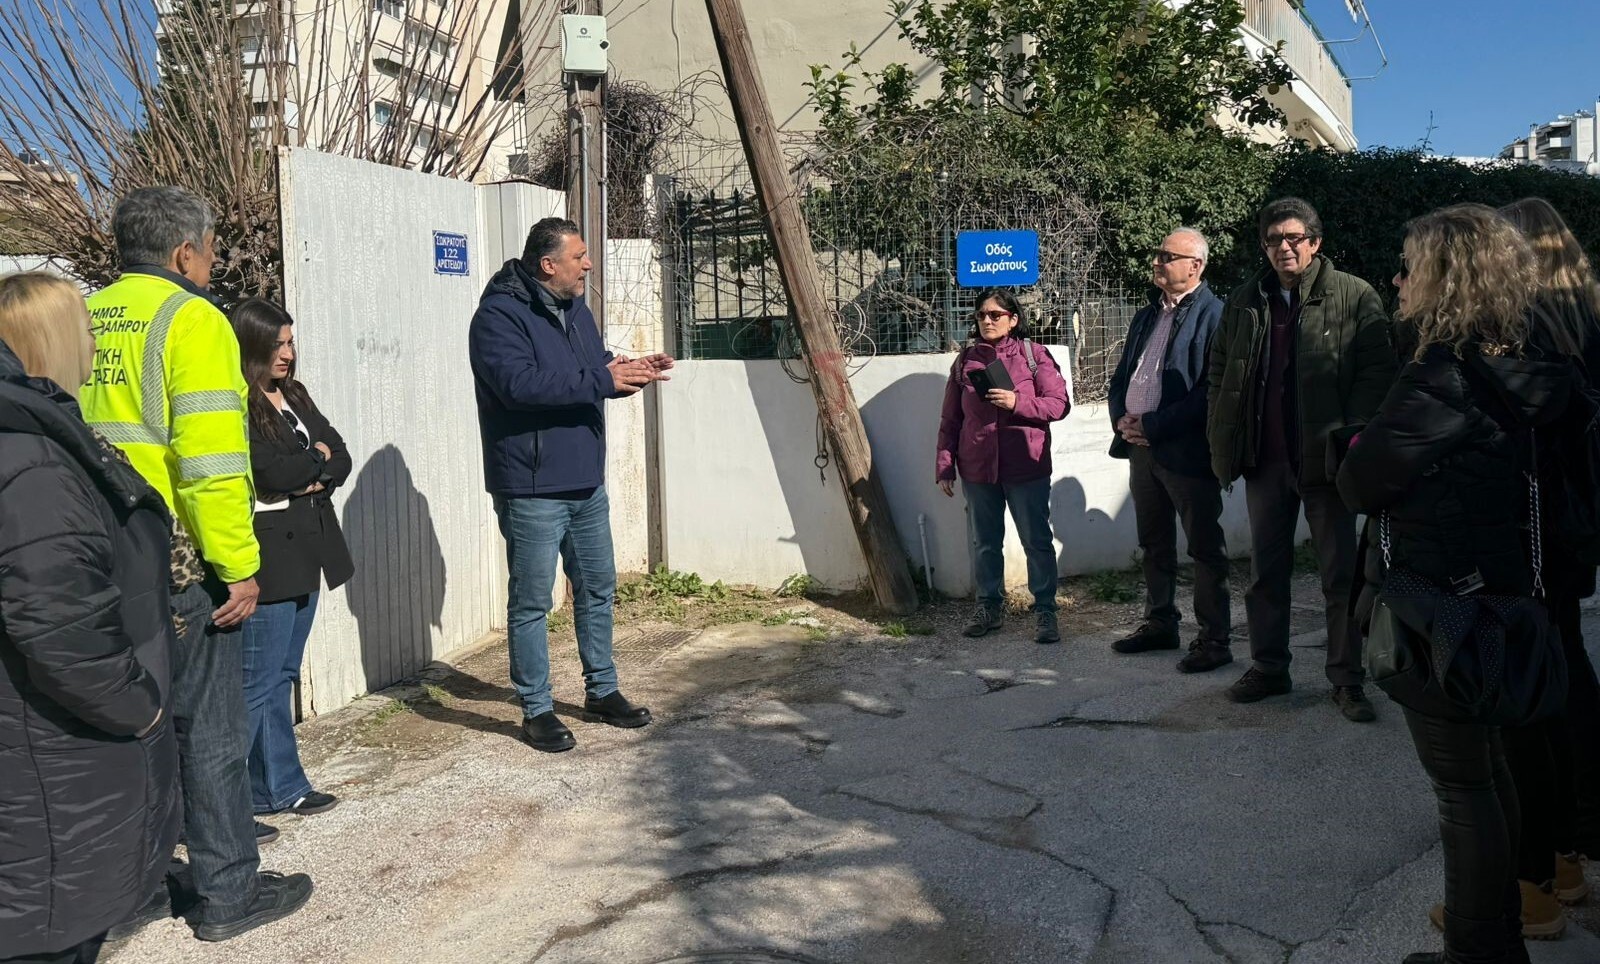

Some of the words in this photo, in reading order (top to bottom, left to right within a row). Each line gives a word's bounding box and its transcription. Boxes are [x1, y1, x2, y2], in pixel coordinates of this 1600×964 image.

[436, 236, 465, 248] ΣΩΚΡΑΤΟΥΣ
[443, 248, 458, 258] 122
[985, 242, 1013, 257] Οδός
[970, 259, 1028, 274] Σωκράτους
[89, 306, 127, 319] ΗΜΟΣ
[104, 320, 149, 333] ΑΛΗΡΟΥ
[95, 348, 123, 366] ΤΙΚΗ
[85, 368, 127, 386] ΤΑΣΙΑ
